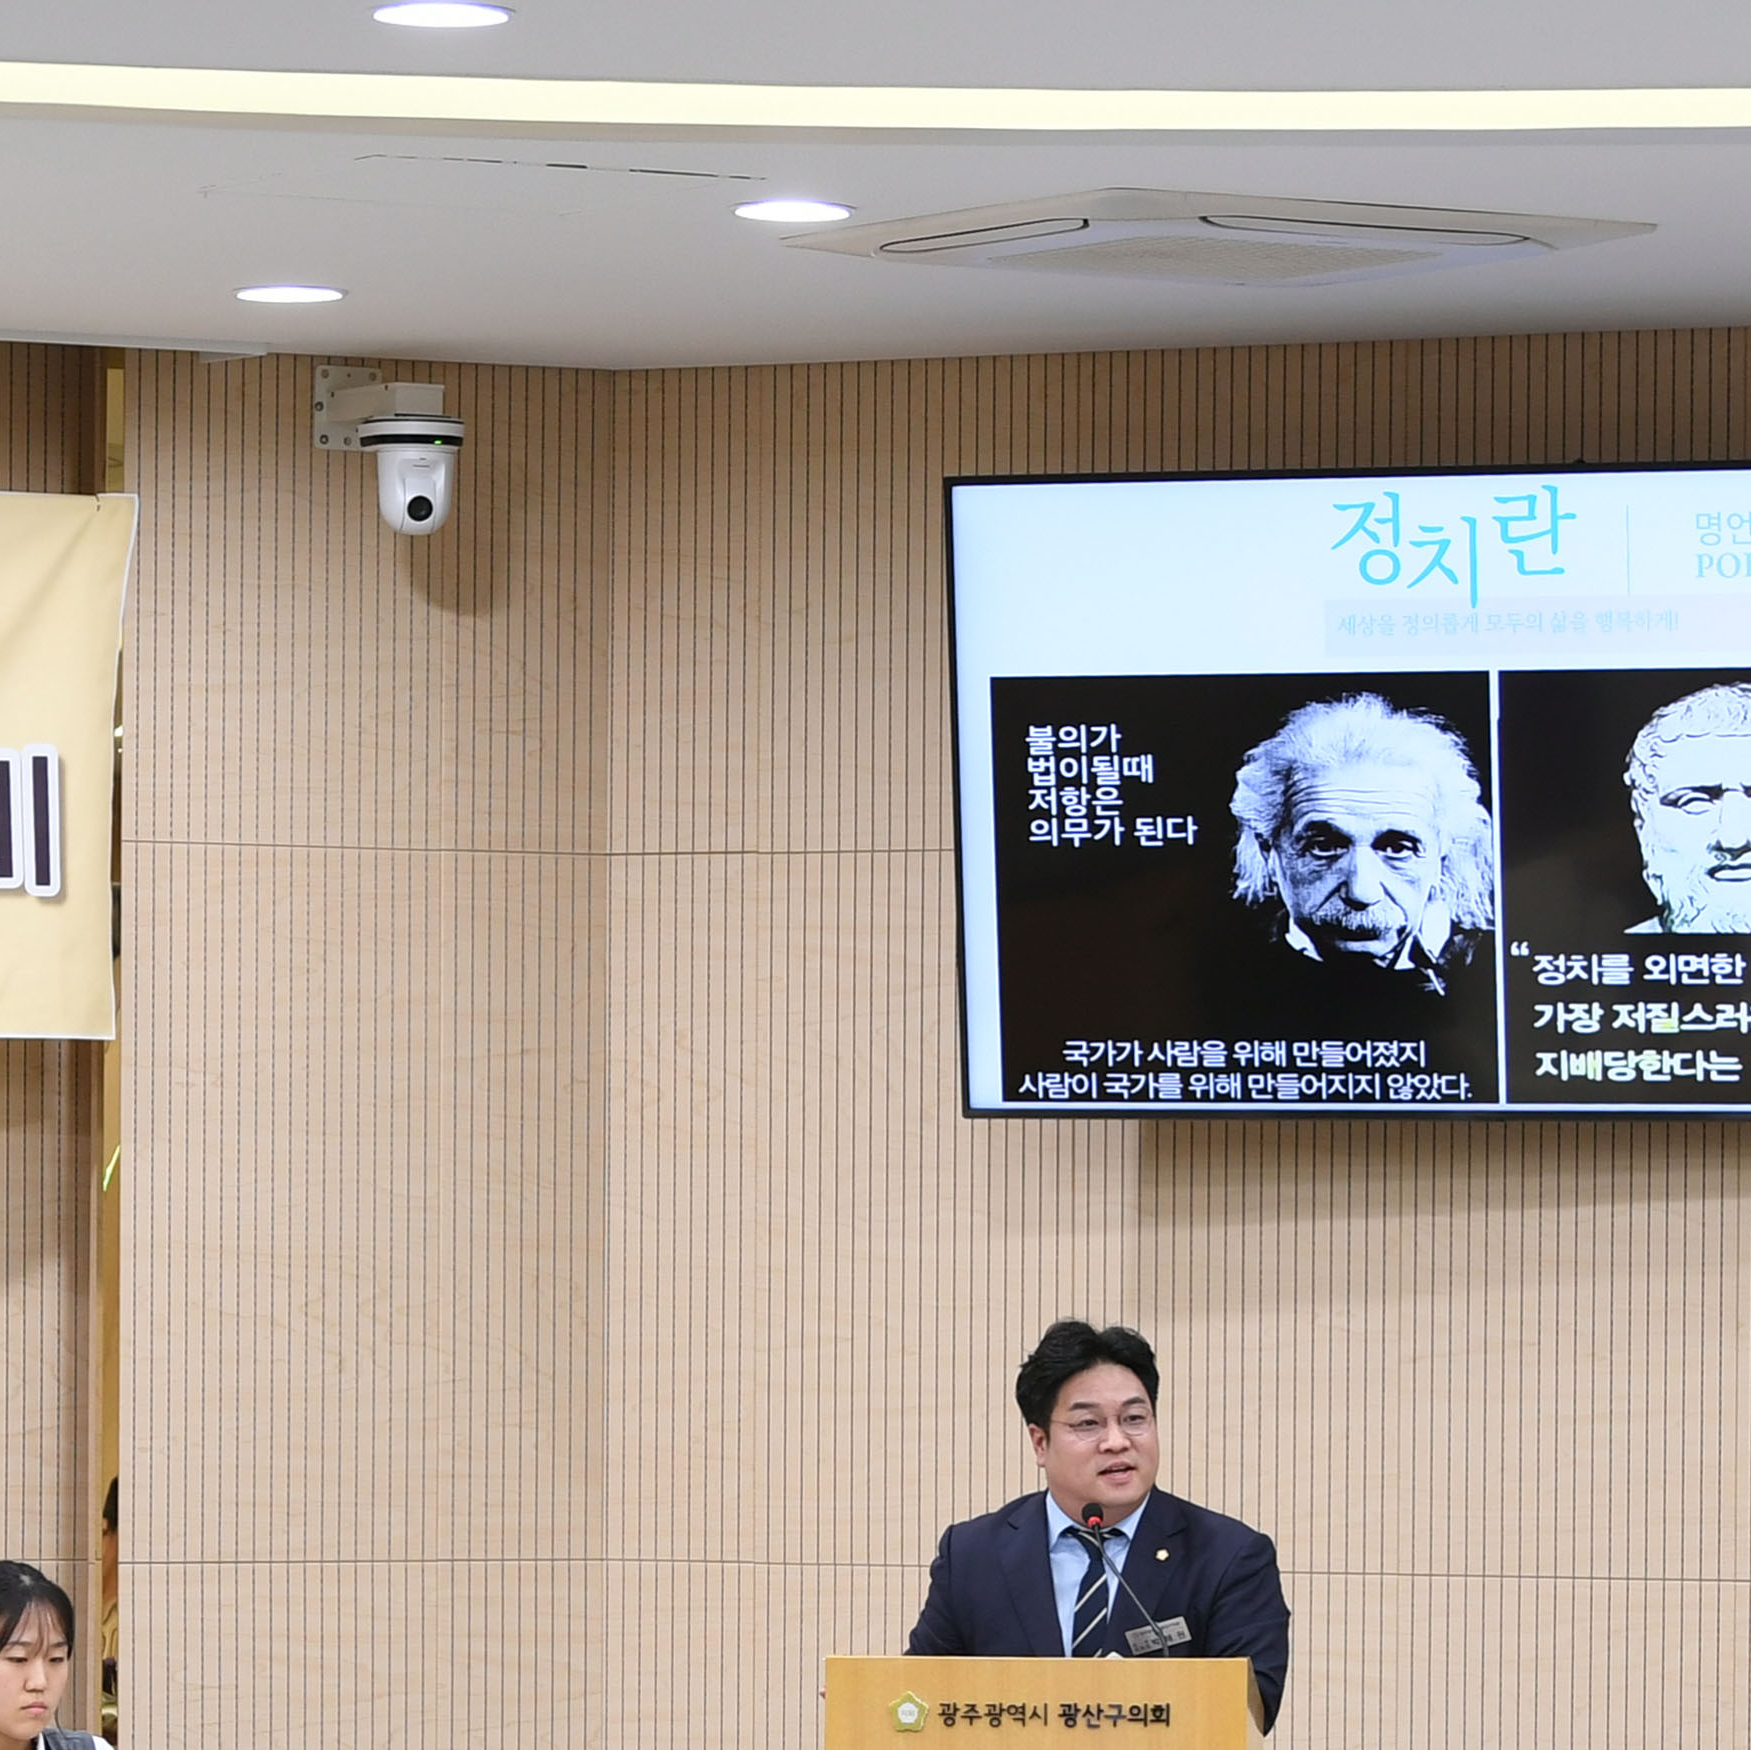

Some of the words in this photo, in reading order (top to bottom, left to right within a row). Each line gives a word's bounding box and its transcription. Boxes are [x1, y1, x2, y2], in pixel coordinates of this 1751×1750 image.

[1331, 484, 1578, 609] 정치란
[1025, 723, 1122, 756] 불의가
[1027, 754, 1154, 786] 법이될때
[1028, 786, 1124, 816] 저항은
[1029, 816, 1125, 847] 의무가
[1133, 815, 1198, 847] 된다
[1643, 952, 1747, 986] 외면한
[1533, 1001, 1605, 1034] 가장
[1062, 1039, 1143, 1067] 국가가
[1147, 1039, 1228, 1068] 사람을
[1232, 1040, 1287, 1068] 위해
[1292, 1040, 1426, 1068] 만들어졌지
[1535, 1049, 1743, 1082] 지배당한다는
[1018, 1071, 1097, 1099] 사람이
[1103, 1072, 1184, 1100] 국가를
[1188, 1072, 1242, 1100] 위해
[1247, 1072, 1381, 1100] 만들어지지
[1386, 1072, 1473, 1100] 않았다.
[937, 1702, 1049, 1729] 광주광역시
[1057, 1702, 1171, 1729] 광산구의회
